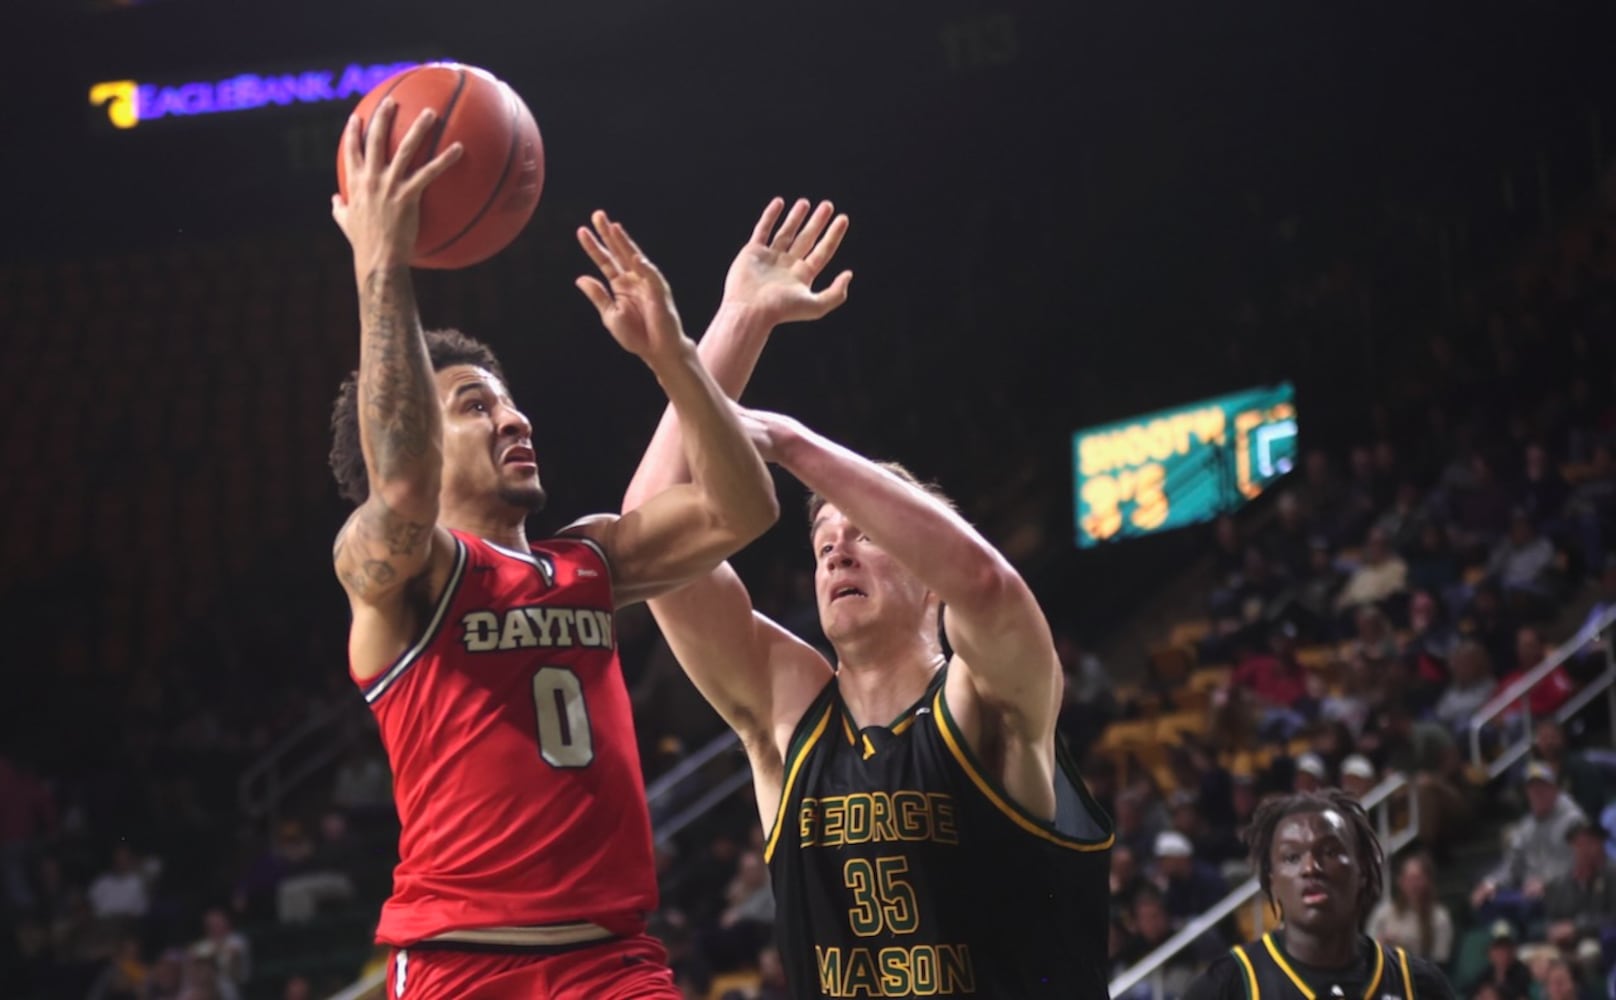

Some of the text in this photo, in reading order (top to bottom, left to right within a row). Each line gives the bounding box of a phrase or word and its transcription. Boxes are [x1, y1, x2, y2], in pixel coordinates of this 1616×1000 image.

[462, 606, 614, 652] DAYTON
[532, 666, 594, 768] 0
[799, 790, 960, 848] GEORGE
[843, 855, 920, 937] 35
[815, 943, 976, 998] MASON
